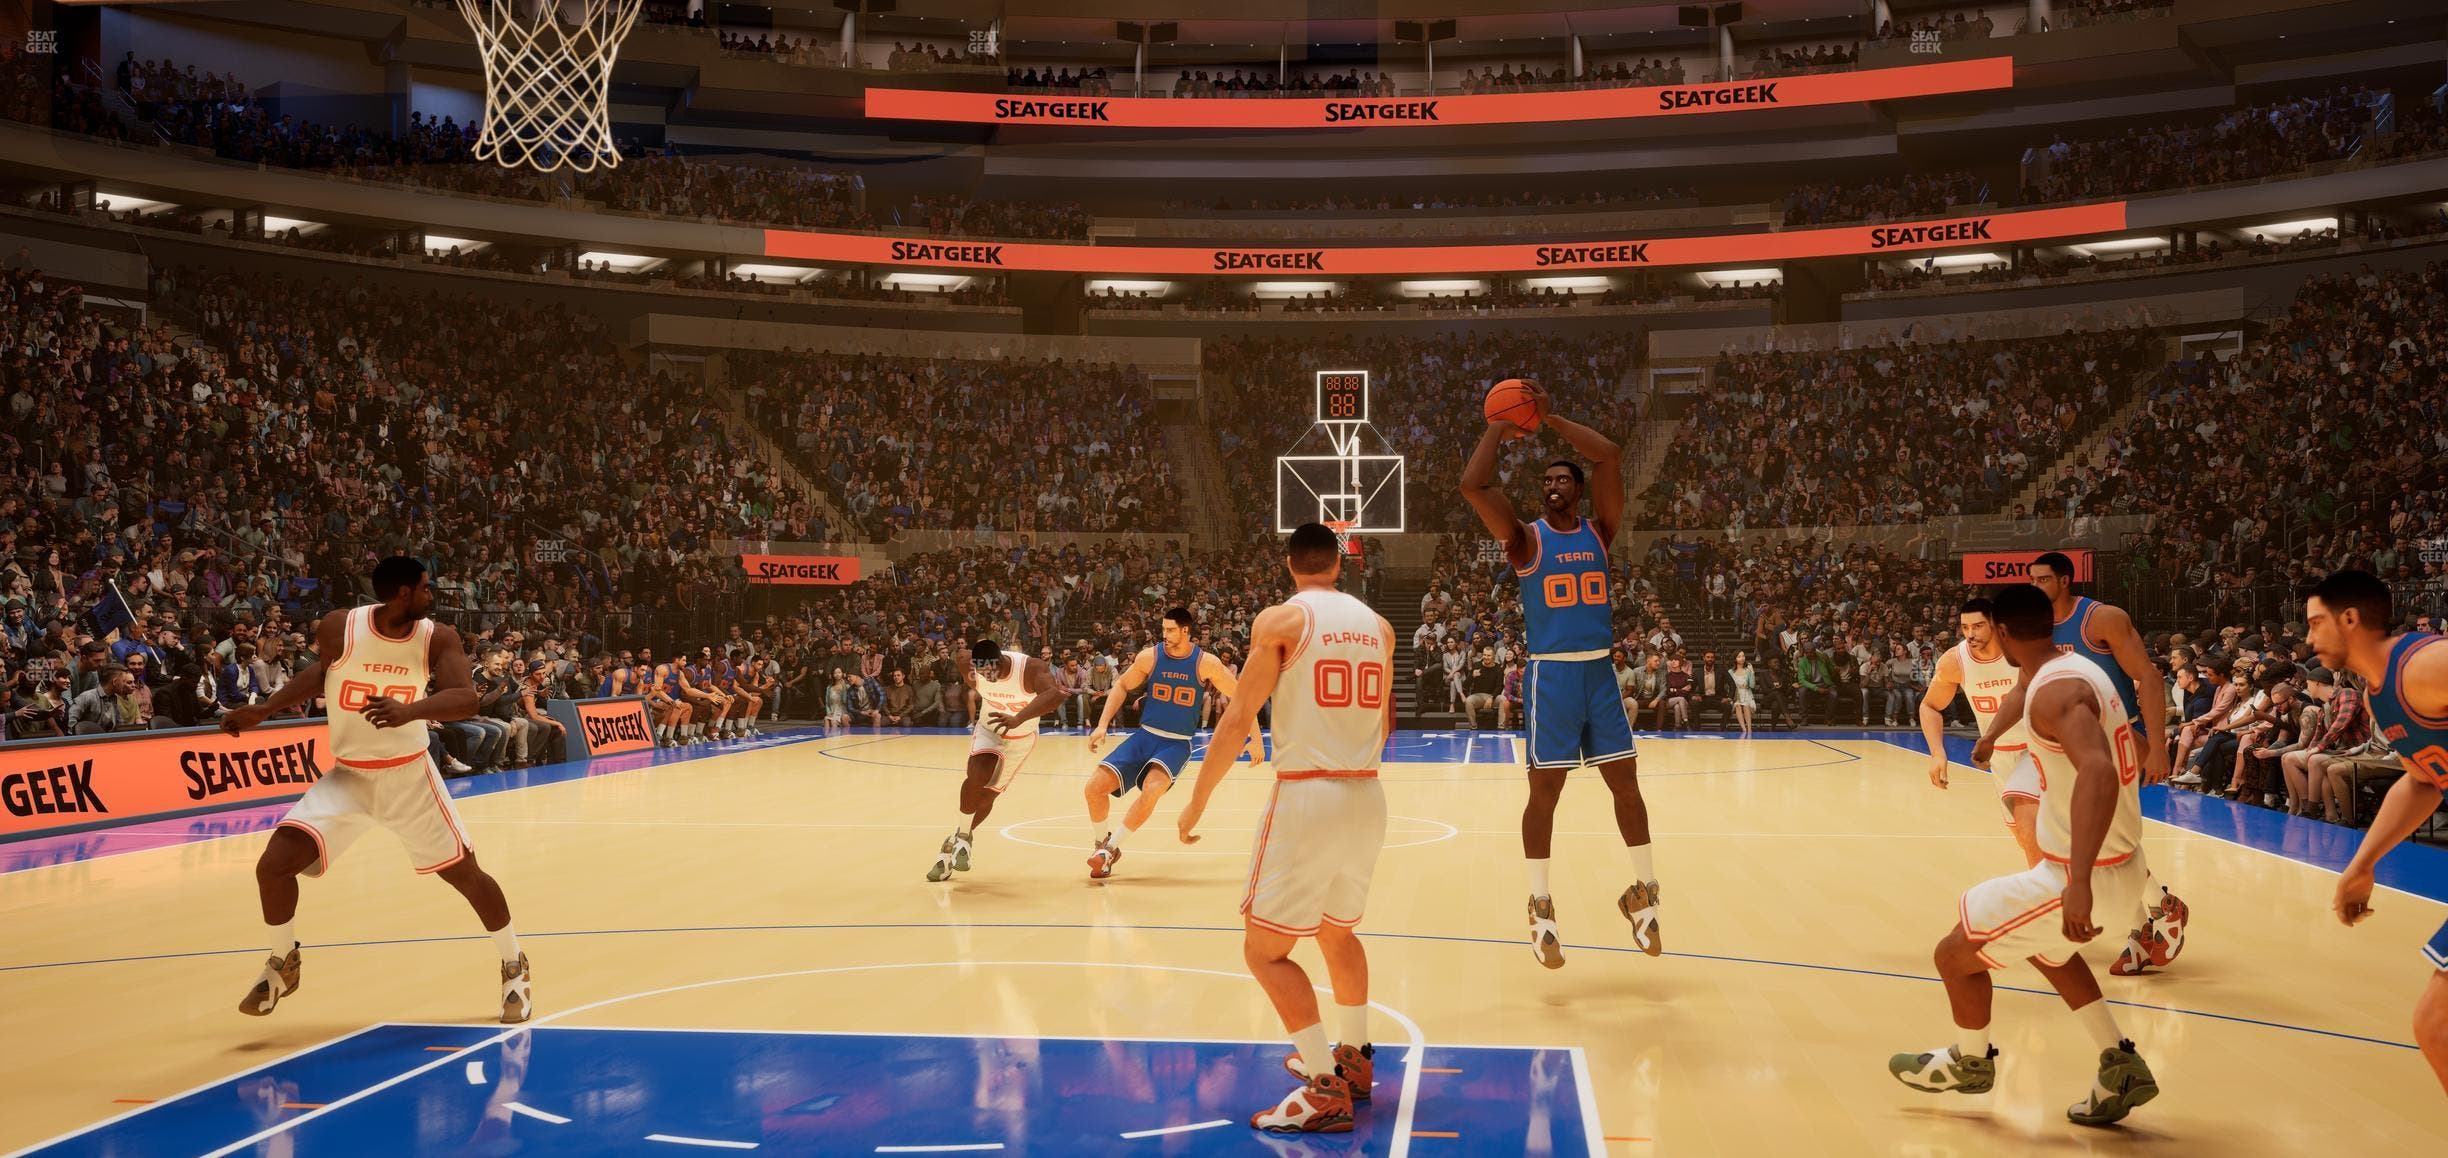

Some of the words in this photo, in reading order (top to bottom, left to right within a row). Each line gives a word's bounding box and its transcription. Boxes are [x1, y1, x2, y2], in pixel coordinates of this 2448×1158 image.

[1660, 83, 1778, 110] SEATGEEK
[995, 100, 1109, 121] SEATGEEK
[1325, 101, 1439, 122] SEATGEEK
[1872, 219, 1992, 248] SEATGEEK
[891, 241, 1003, 265] SEATGEEK
[1214, 252, 1324, 270] SEATGEEK
[1536, 243, 1649, 266] SEATGEEK
[1330, 394, 1354, 416] 88
[1555, 551, 1595, 563] TEAM
[760, 562, 840, 581] SEATGEEK
[1543, 571, 1608, 609] 00
[1322, 632, 1379, 650] PLAYER
[362, 663, 409, 676] TEAM
[1162, 671, 1189, 681] TEAM
[1152, 682, 1196, 707] 00
[1314, 658, 1383, 709] 00
[1976, 678, 2012, 689] TEAM
[987, 691, 1016, 700] TEAM
[585, 710, 650, 748] SEATGEEK
[180, 738, 325, 801] SEATGEEK
[1, 759, 109, 818] GEEK
